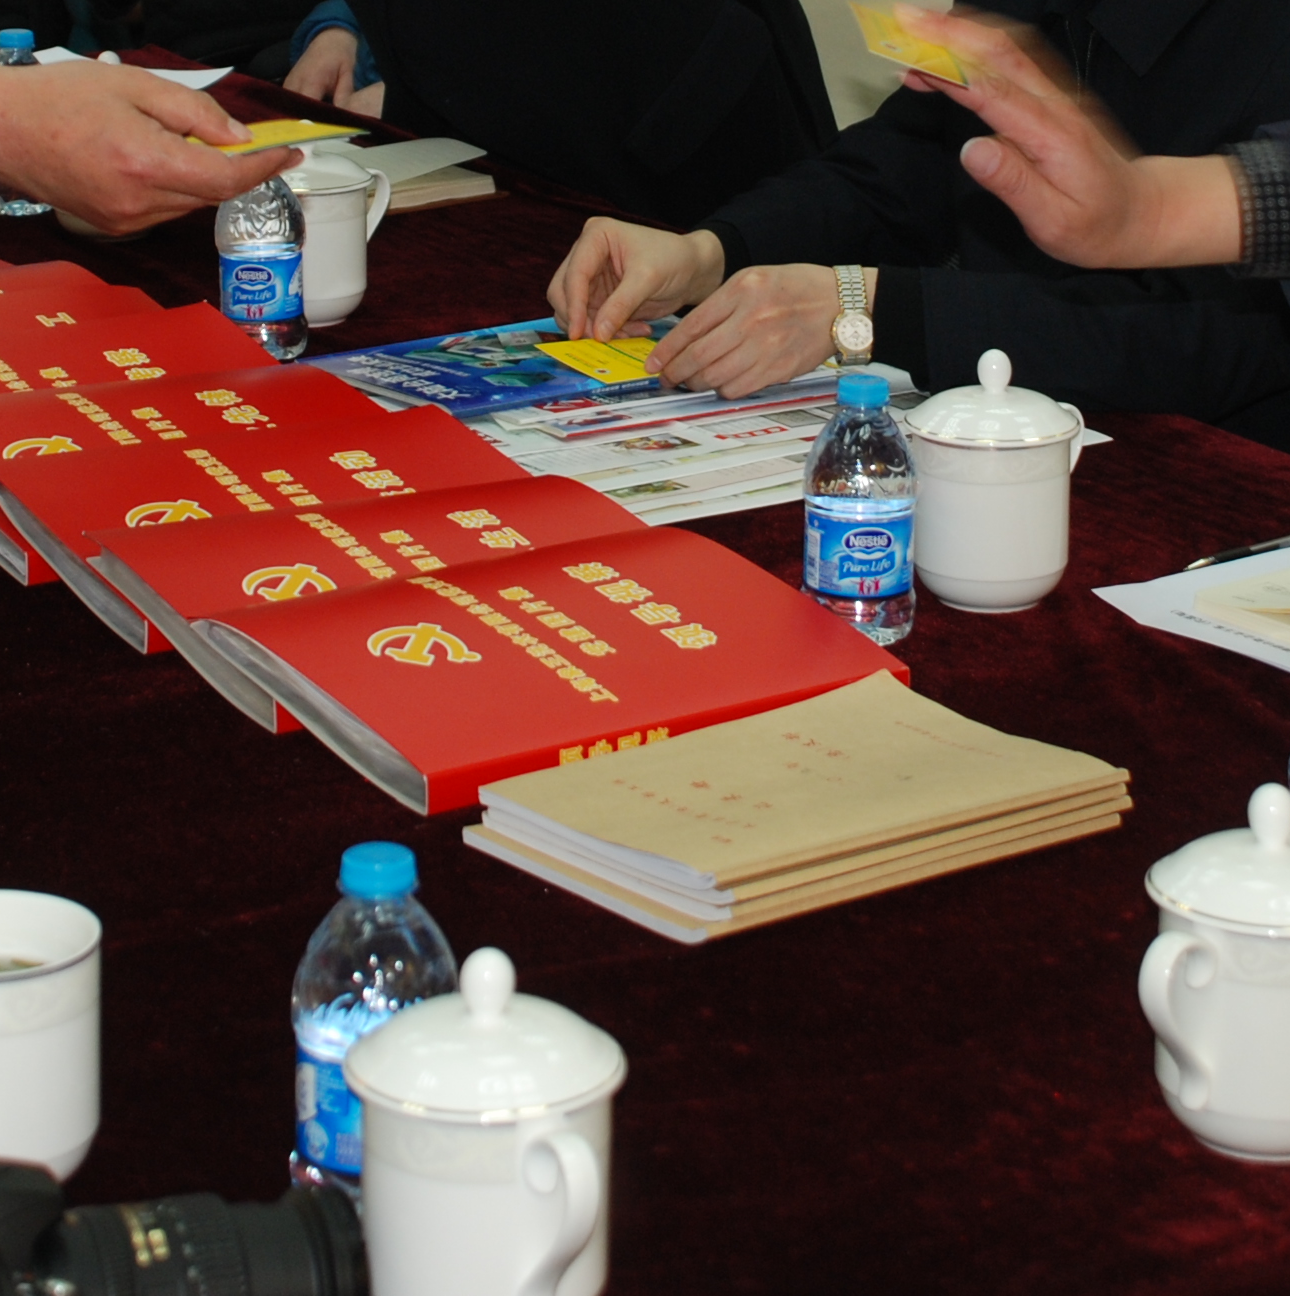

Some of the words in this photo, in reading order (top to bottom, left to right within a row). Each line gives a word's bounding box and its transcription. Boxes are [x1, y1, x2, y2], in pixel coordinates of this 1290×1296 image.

[195, 389, 276, 431] 先锋
[841, 560, 870, 574] Pure
[870, 558, 892, 573] Life
[498, 586, 617, 657] 党建图片集
[562, 562, 718, 650] 领导视察
